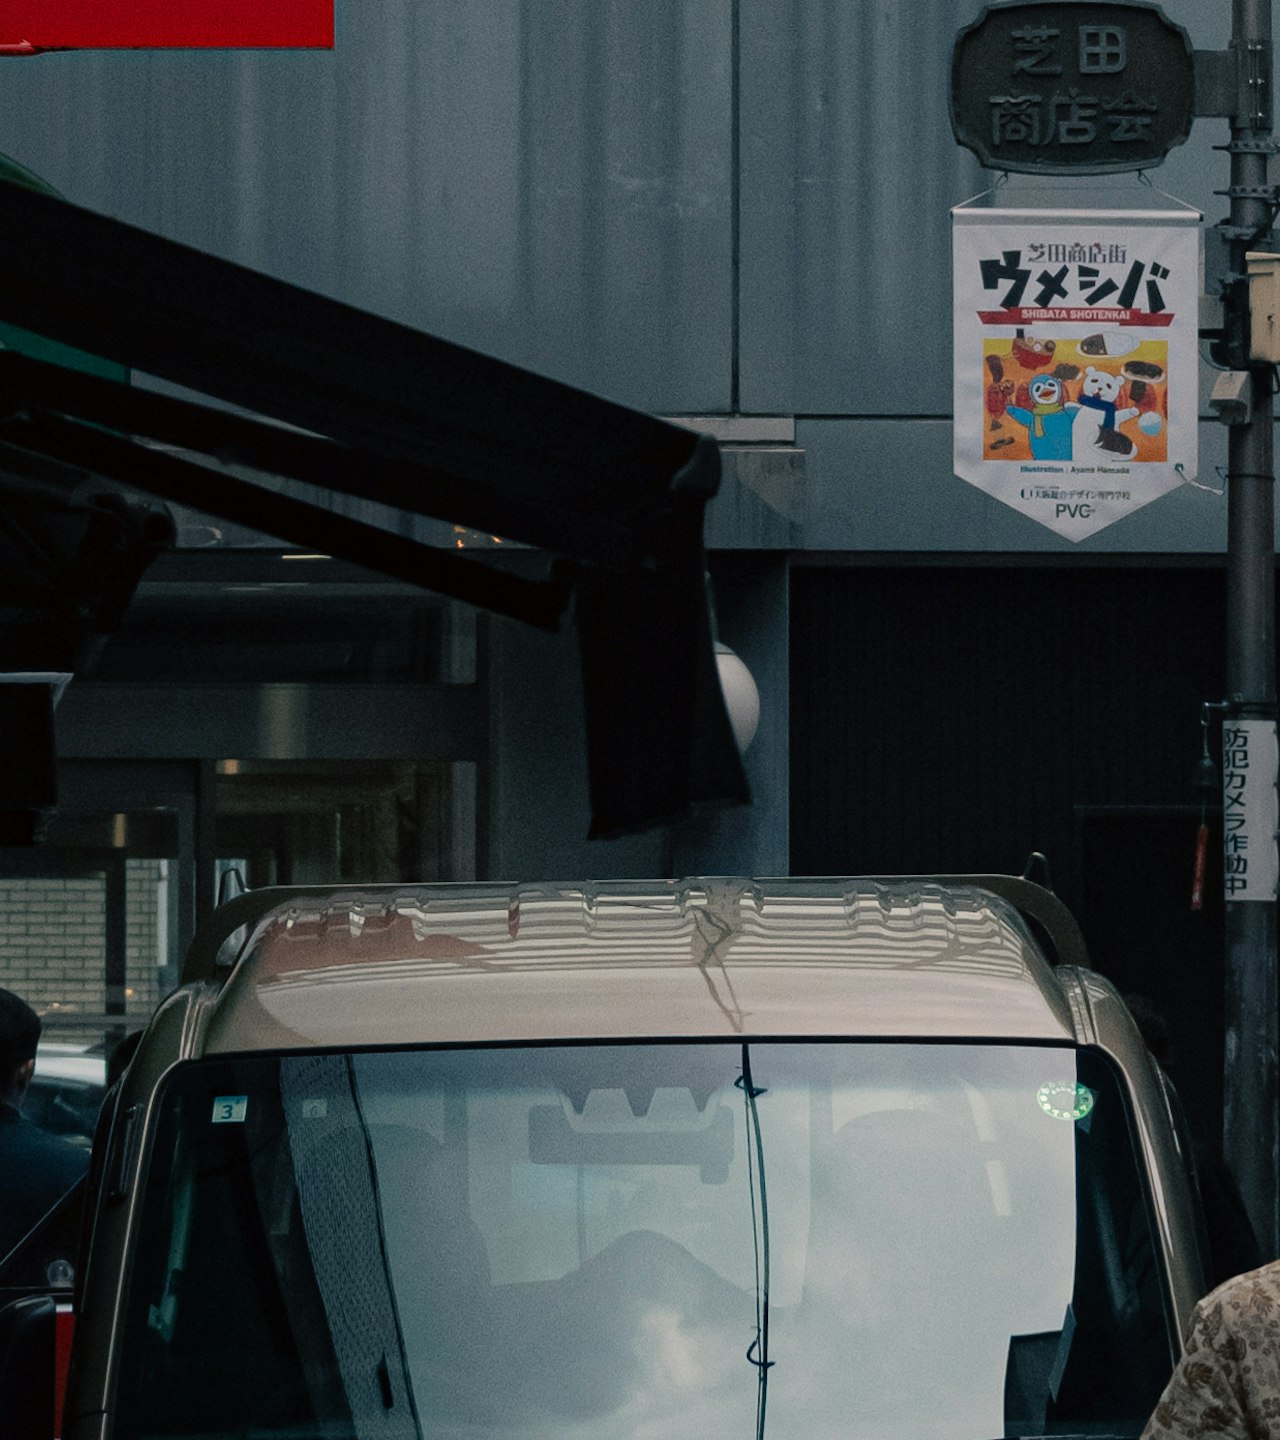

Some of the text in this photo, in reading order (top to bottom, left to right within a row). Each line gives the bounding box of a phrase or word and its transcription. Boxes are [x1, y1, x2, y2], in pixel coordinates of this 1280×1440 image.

[1010, 23, 1126, 77] 芝田
[988, 87, 1159, 147] 商店会
[1027, 242, 1128, 265] 芝田商店街
[979, 250, 1171, 314] ウメシバ
[1021, 309, 1131, 320] SHIBATA SHOTENKAI
[1056, 503, 1092, 519] PVC
[1223, 727, 1250, 896] 防犯カメラ作動中
